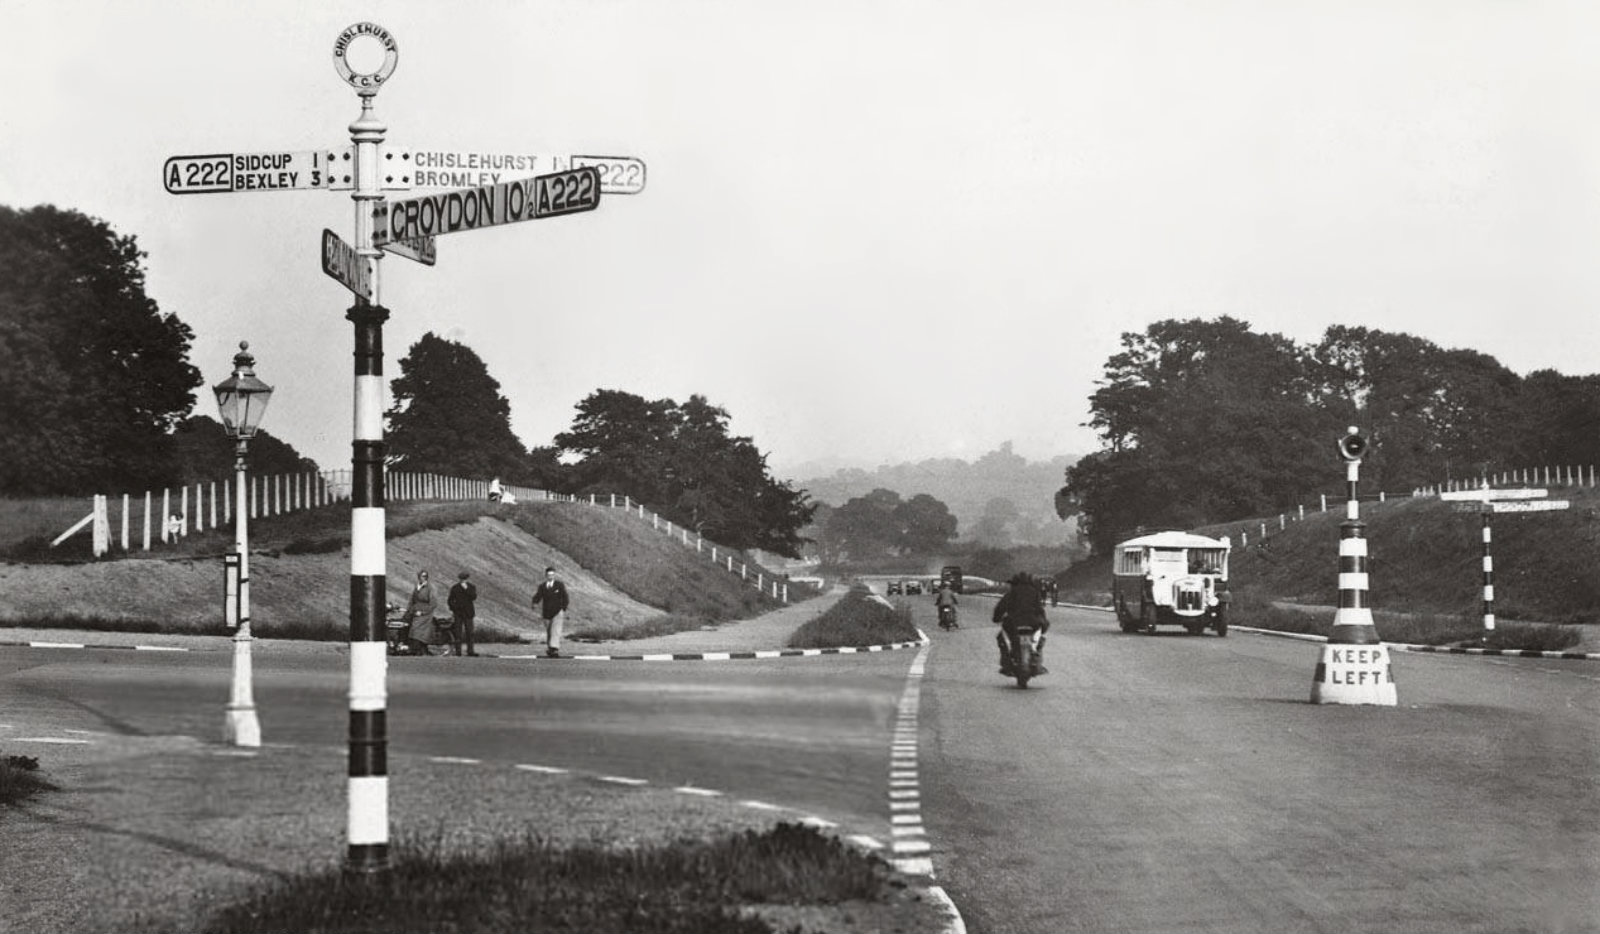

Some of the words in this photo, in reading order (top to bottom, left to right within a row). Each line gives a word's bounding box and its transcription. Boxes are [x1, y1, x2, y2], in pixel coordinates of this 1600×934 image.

[335, 24, 396, 57] CHISLEHURST
[235, 154, 292, 171] SIDCUP
[313, 152, 318, 168] 1
[415, 152, 538, 170] CHISLEHURST
[235, 172, 298, 189] BEXLEY
[311, 171, 321, 186] 3
[415, 171, 501, 188] BROMLEY
[579, 162, 641, 187] 222
[538, 171, 593, 213] A222
[391, 186, 495, 239] CROYDON
[1333, 649, 1381, 663] KEEP
[1333, 671, 1381, 685] LEFT
